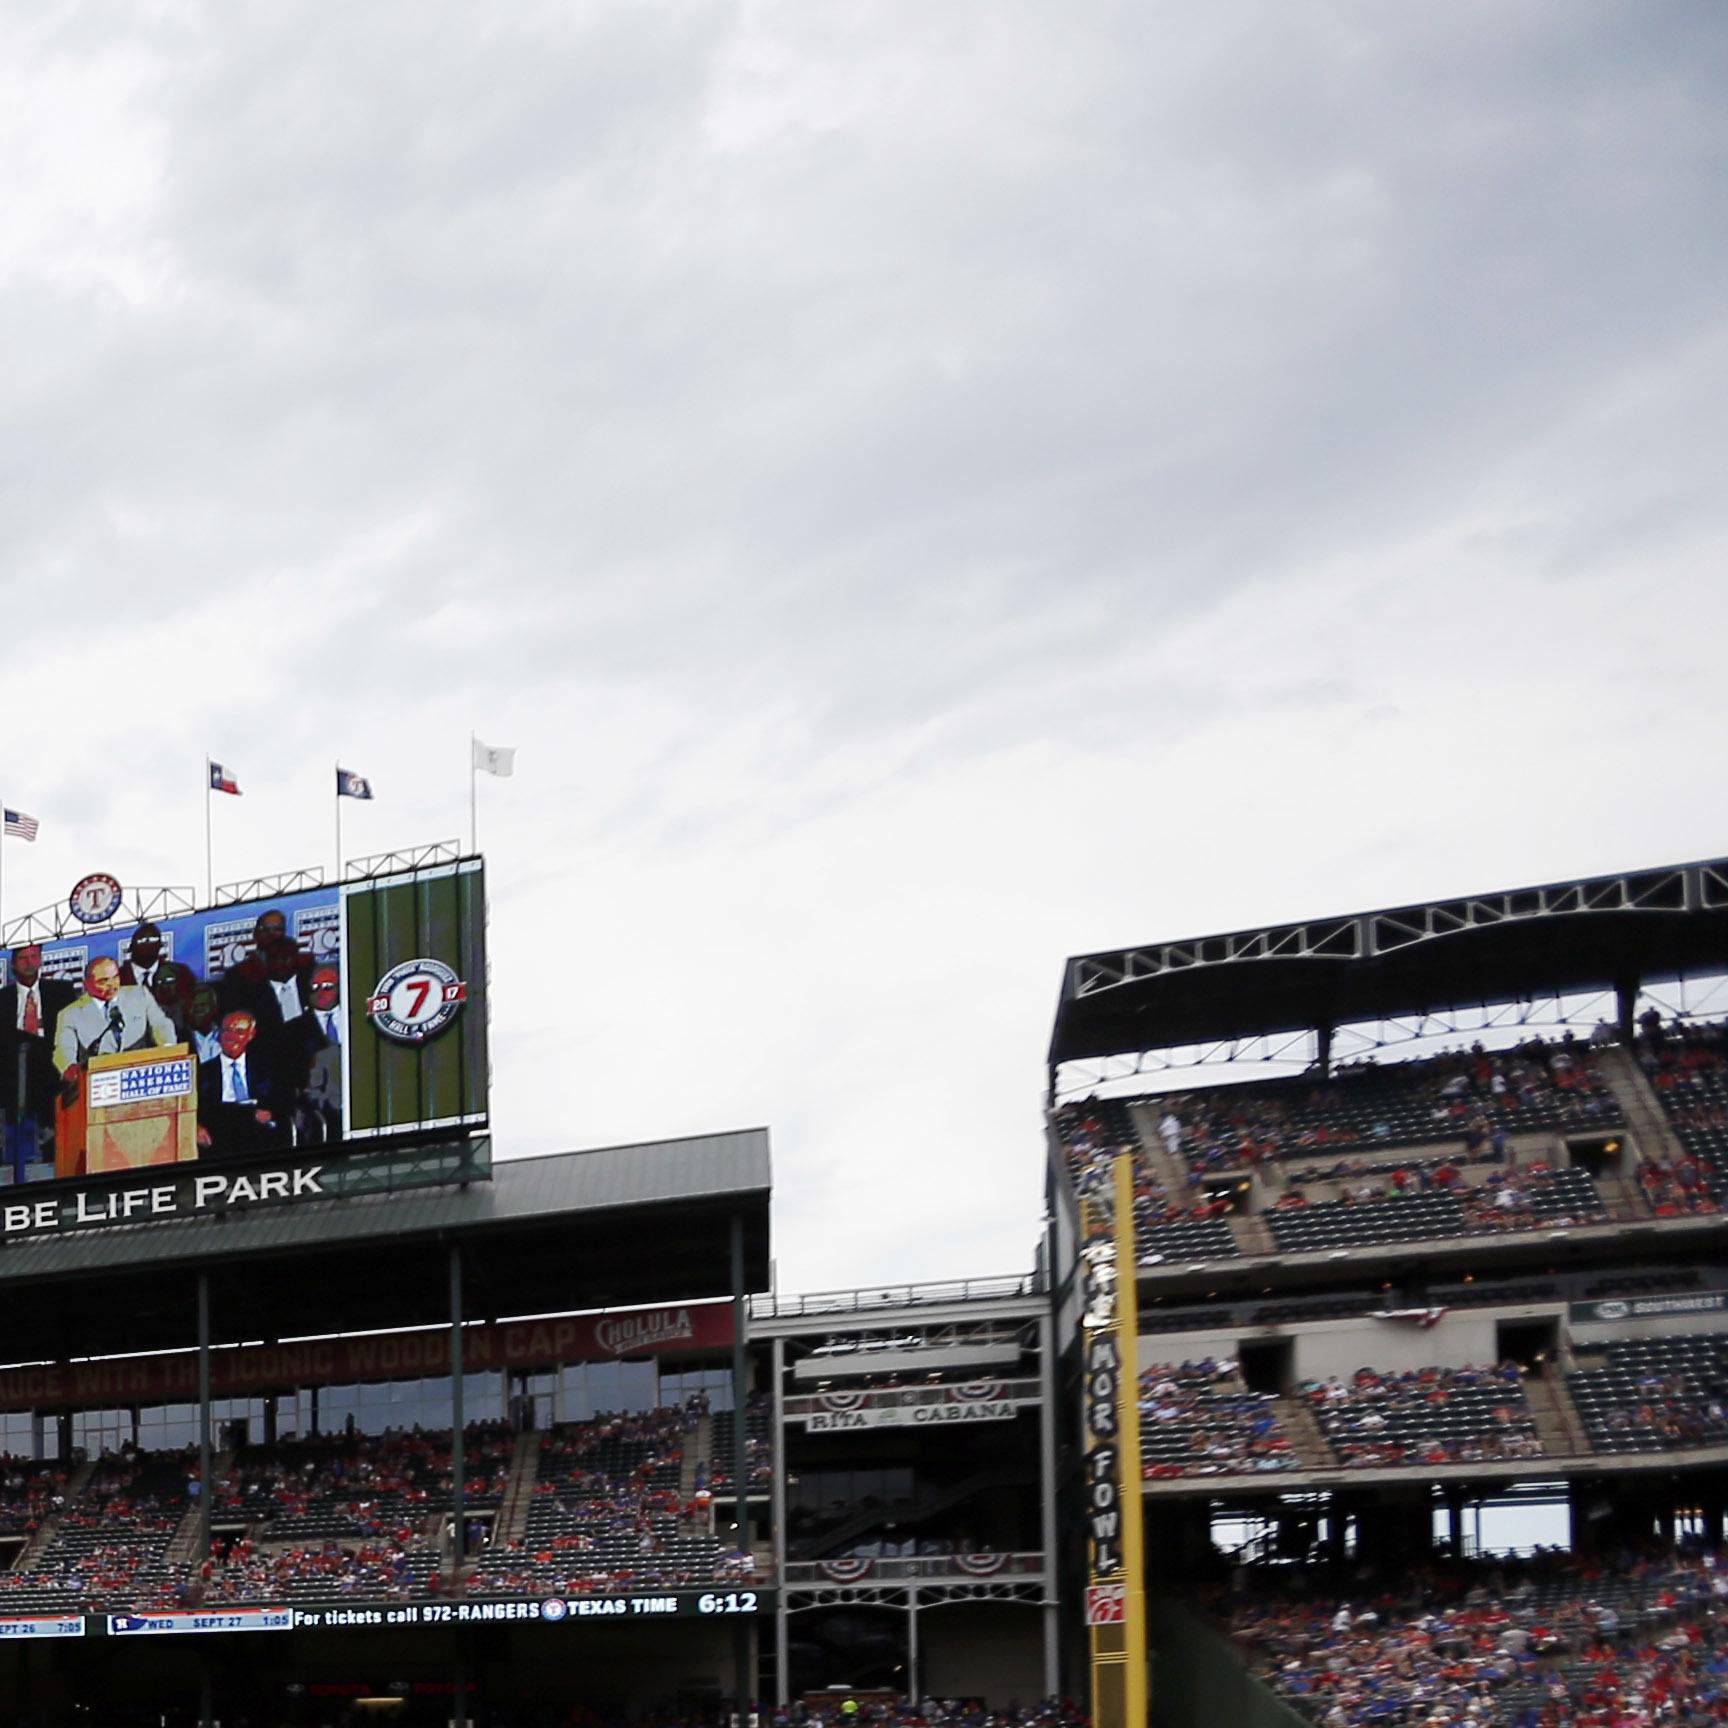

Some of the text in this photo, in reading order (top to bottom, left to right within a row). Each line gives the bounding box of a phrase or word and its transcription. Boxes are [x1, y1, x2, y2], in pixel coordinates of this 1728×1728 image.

[407, 981, 430, 1018] 7
[122, 1063, 189, 1079] NATIONAL
[122, 1073, 189, 1089] BASEBALL
[77, 1185, 177, 1223] LIFE
[194, 1167, 324, 1208] PARK
[595, 1310, 693, 1350] CHOLULA
[74, 1366, 143, 1394] WITH
[230, 1350, 334, 1381] ICONIC
[505, 1325, 575, 1358] CAP
[1088, 1342, 1116, 1431] MOR
[811, 1403, 1015, 1430] RITA CABANA
[1091, 1451, 1118, 1572] FOWL
[294, 1602, 540, 1627] For tickets call 972-RANGERS
[566, 1597, 678, 1616] TEXAS TIME
[697, 1593, 759, 1614] 6:12
[21, 1623, 36, 1633] 26
[57, 1622, 81, 1633] 7:05
[147, 1614, 289, 1630] WED SEPT 27 1:05
